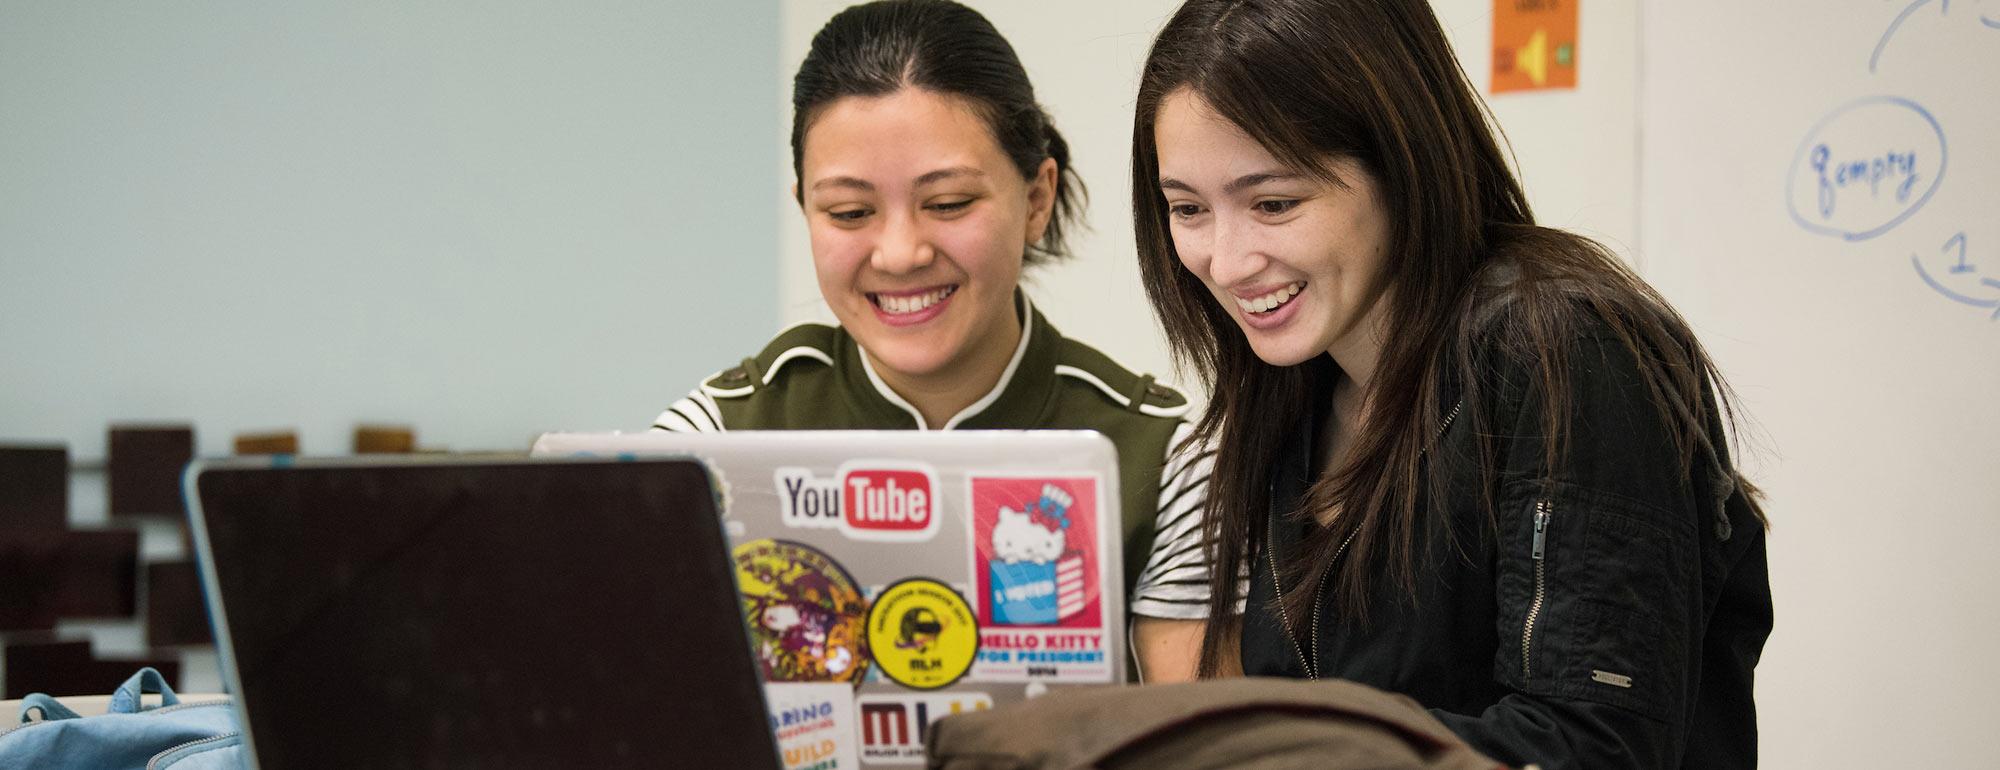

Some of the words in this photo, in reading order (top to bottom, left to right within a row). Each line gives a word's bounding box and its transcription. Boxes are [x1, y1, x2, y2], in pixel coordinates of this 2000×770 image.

[785, 477, 928, 523] YouTube
[978, 634, 1038, 650] HELLO
[1045, 634, 1102, 651] KITTY
[978, 650, 1010, 663] FOR
[1018, 650, 1105, 663] PRESIDENT
[784, 740, 837, 768] UILD
